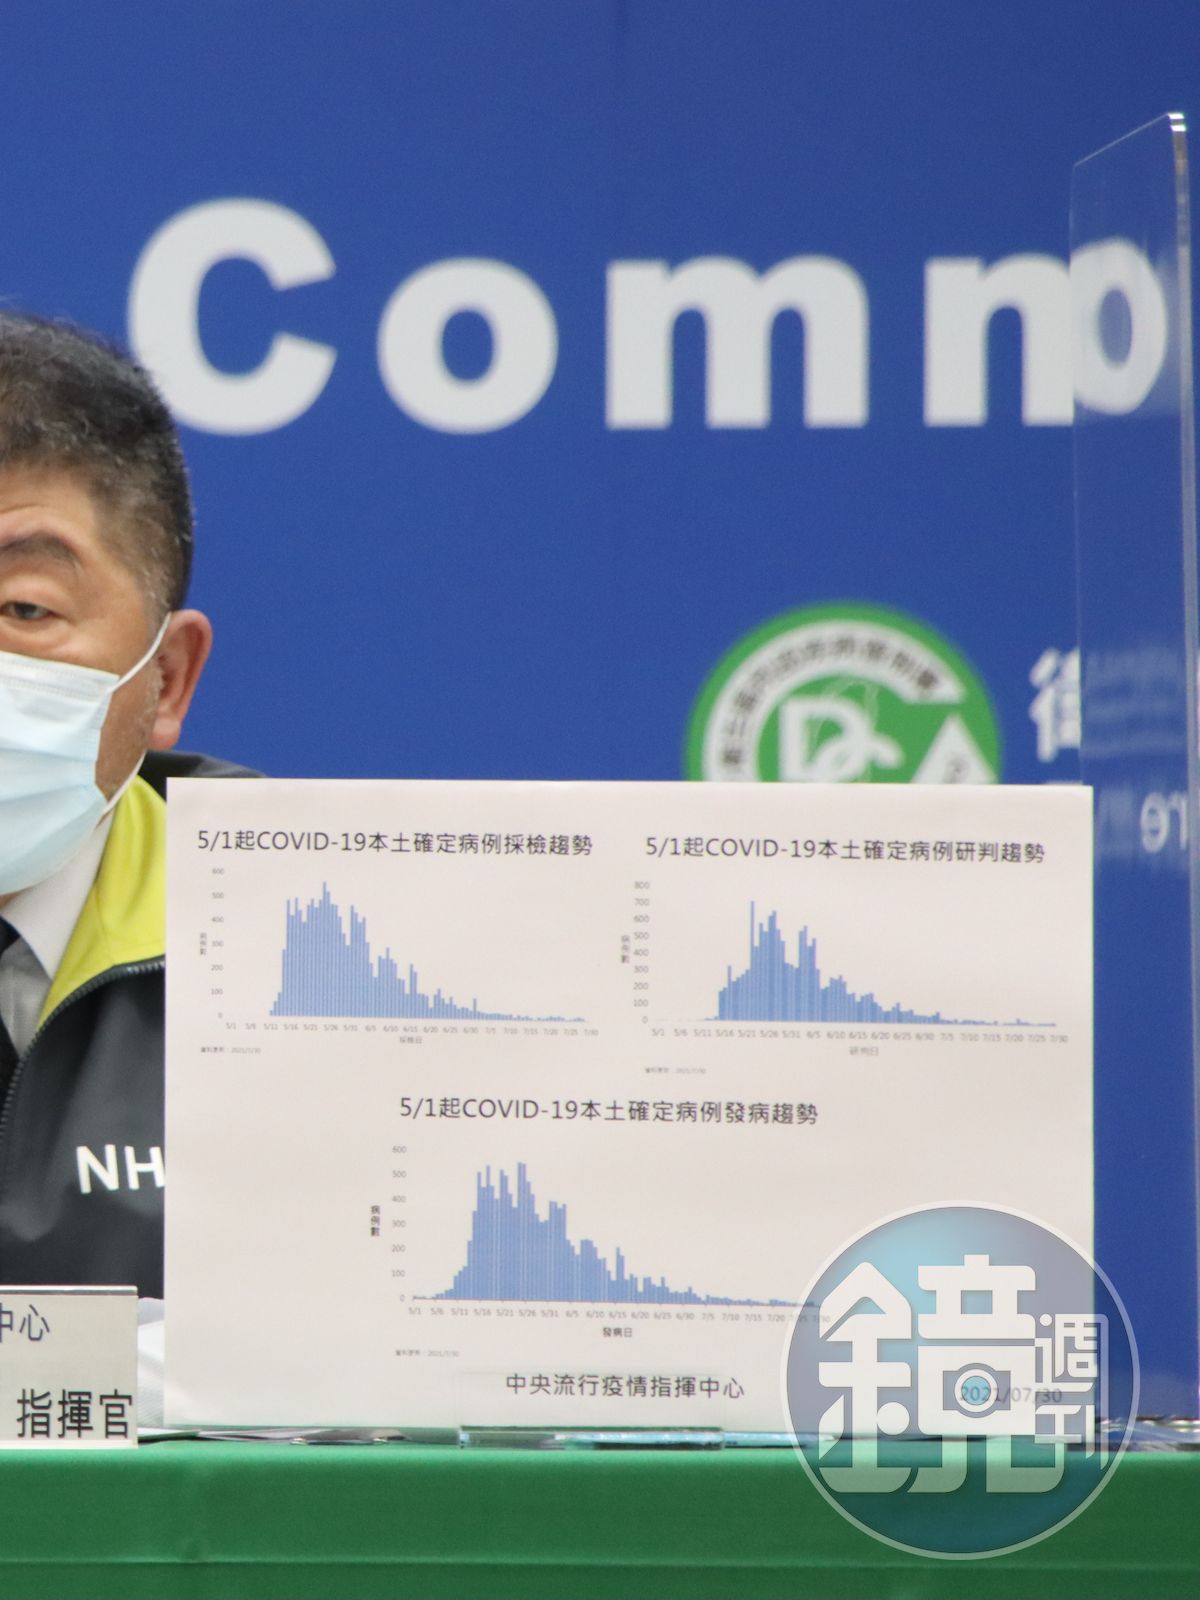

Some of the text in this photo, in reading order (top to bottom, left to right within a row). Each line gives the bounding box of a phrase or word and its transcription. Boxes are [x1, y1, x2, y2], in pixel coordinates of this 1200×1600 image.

[76, 1144, 165, 1194] NH
[506, 1373, 745, 1399] 中央流行疫情指揮中心
[17, 1388, 133, 1439] 指揮官
